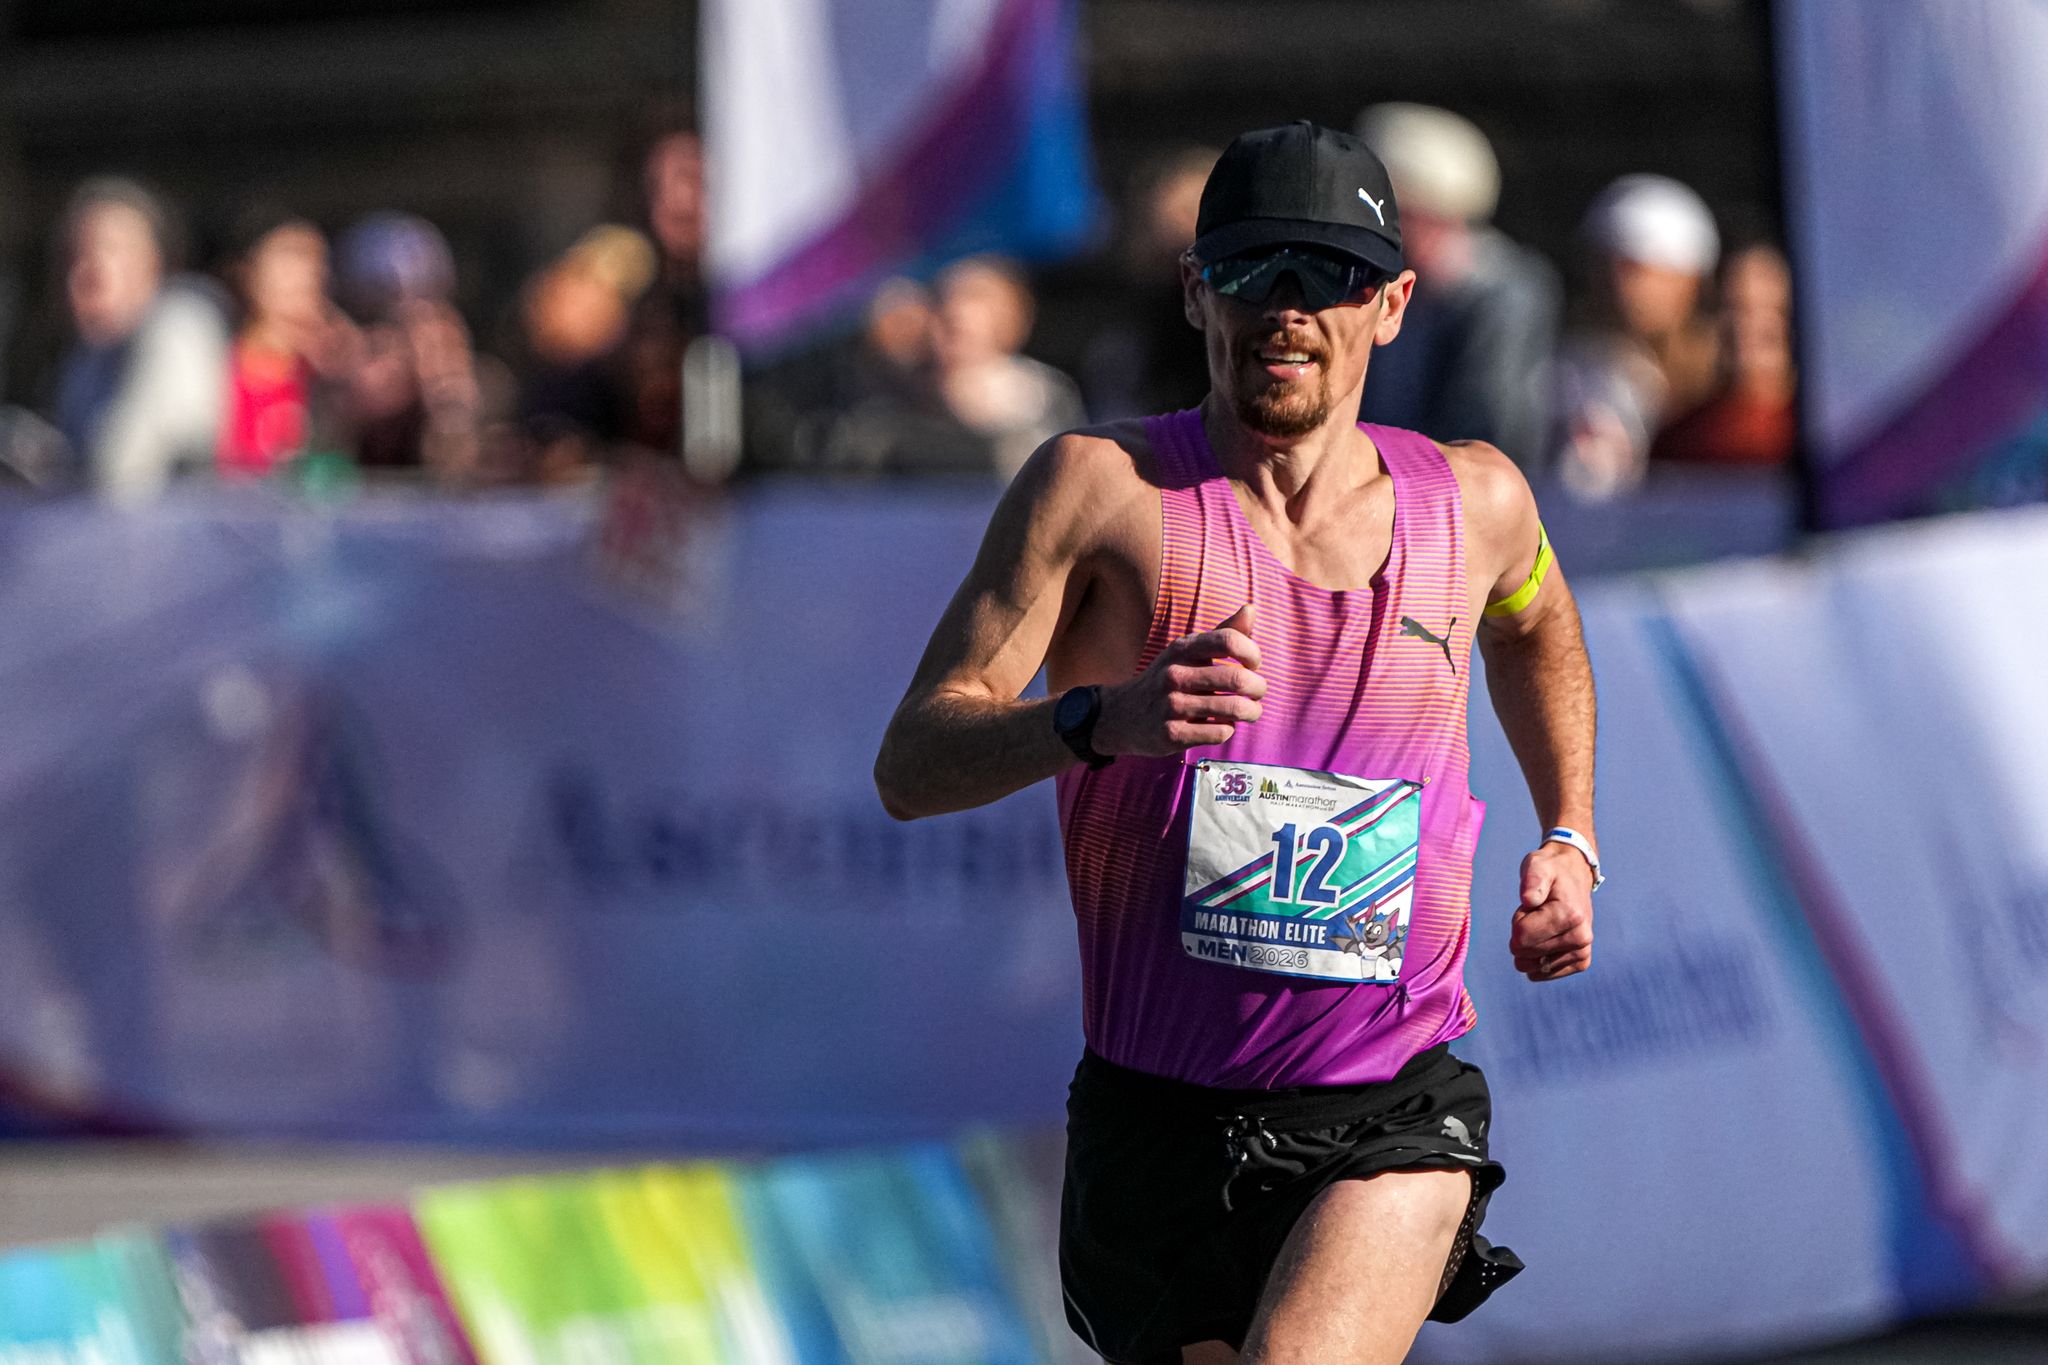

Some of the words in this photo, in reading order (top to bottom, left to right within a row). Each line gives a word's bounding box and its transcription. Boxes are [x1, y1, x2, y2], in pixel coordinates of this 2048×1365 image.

[1270, 822, 1345, 905] 12
[1194, 911, 1280, 939] MARATHON
[1284, 922, 1328, 945] ELITE
[1197, 939, 1247, 961] MEN
[1249, 946, 1309, 969] 2026
